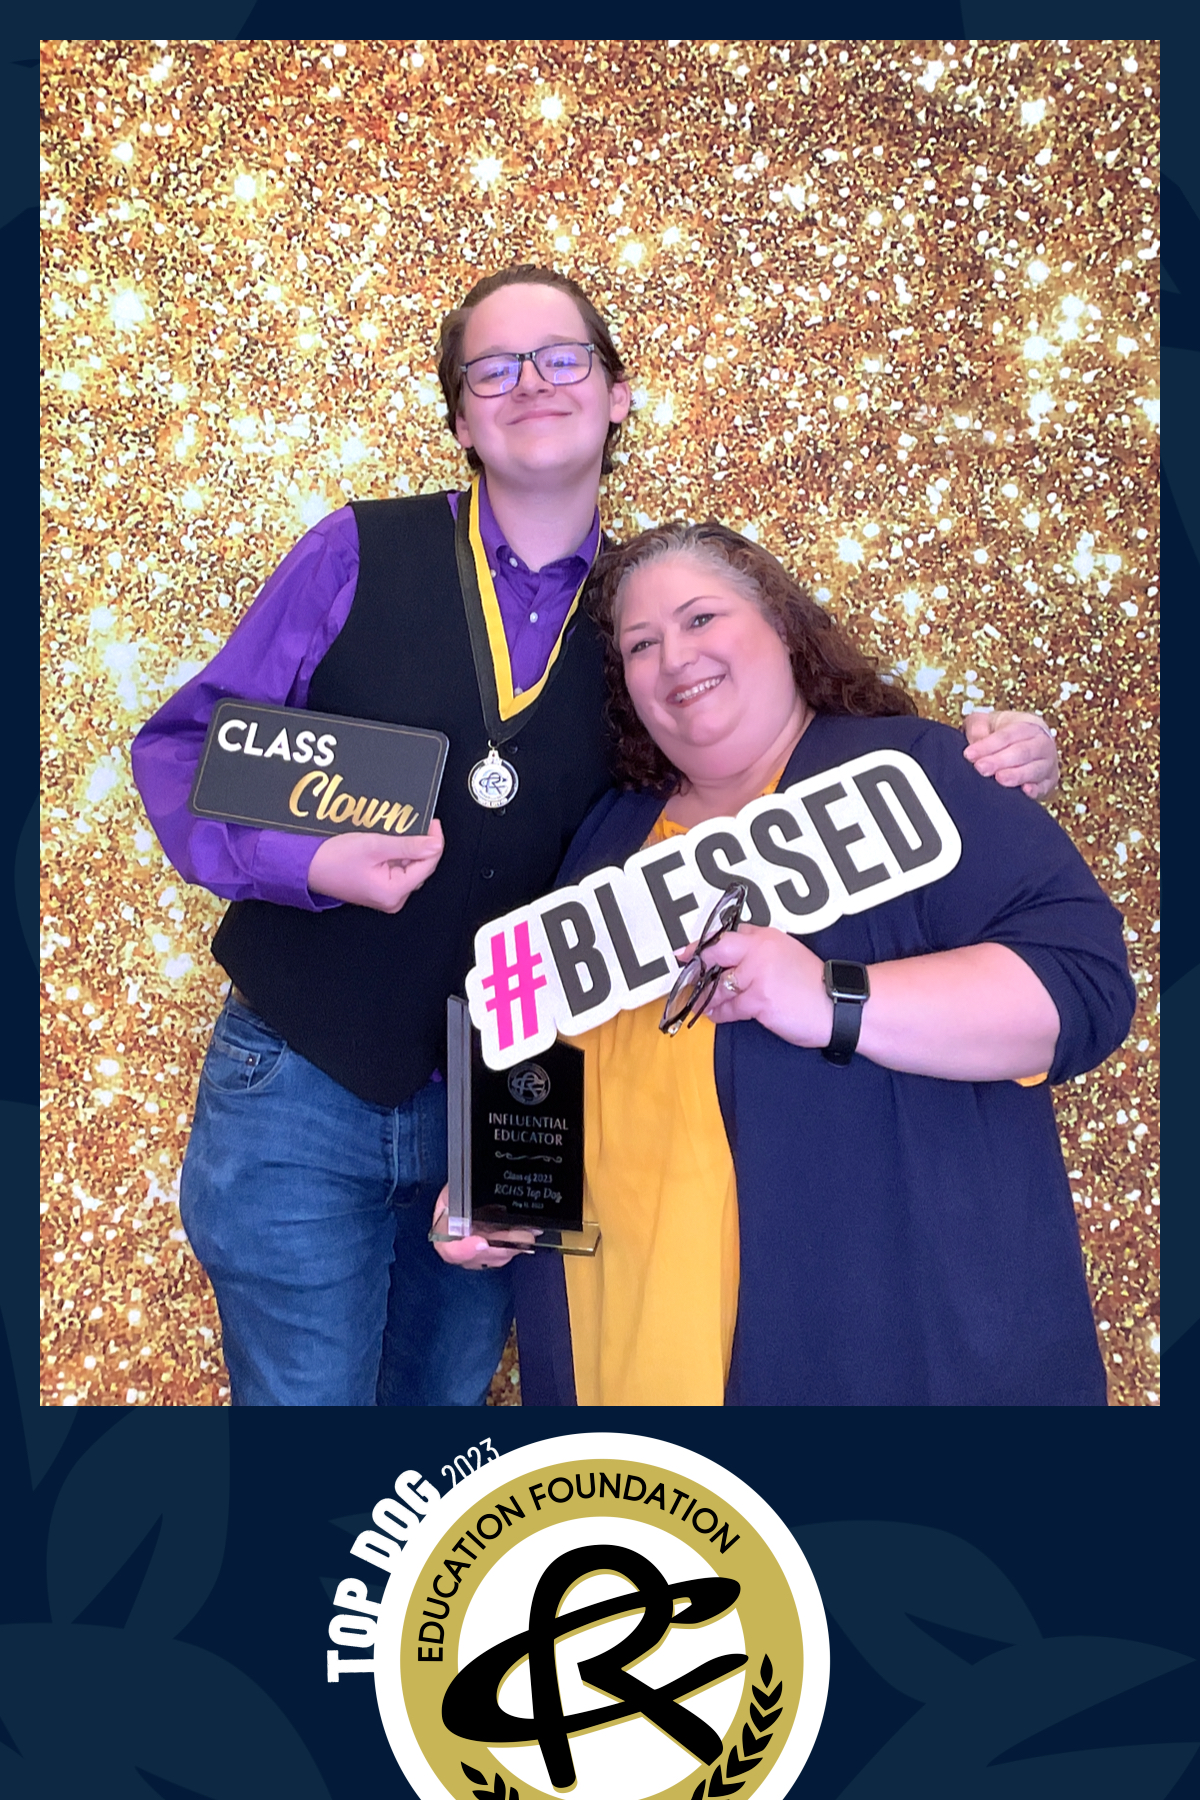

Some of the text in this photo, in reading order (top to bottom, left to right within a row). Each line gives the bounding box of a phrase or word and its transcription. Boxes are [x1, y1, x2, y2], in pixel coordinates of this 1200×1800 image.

[217, 719, 338, 767] CLASS
[289, 770, 420, 834] Clown
[481, 764, 943, 1051] #BLESSED
[488, 1112, 569, 1131] INFLUENTIAL
[494, 1128, 563, 1146] EDUCATOR
[503, 1170, 523, 1181] Class
[532, 1172, 553, 1184] 2023
[526, 1186, 541, 1200] Top
[543, 1187, 563, 1204] Dog
